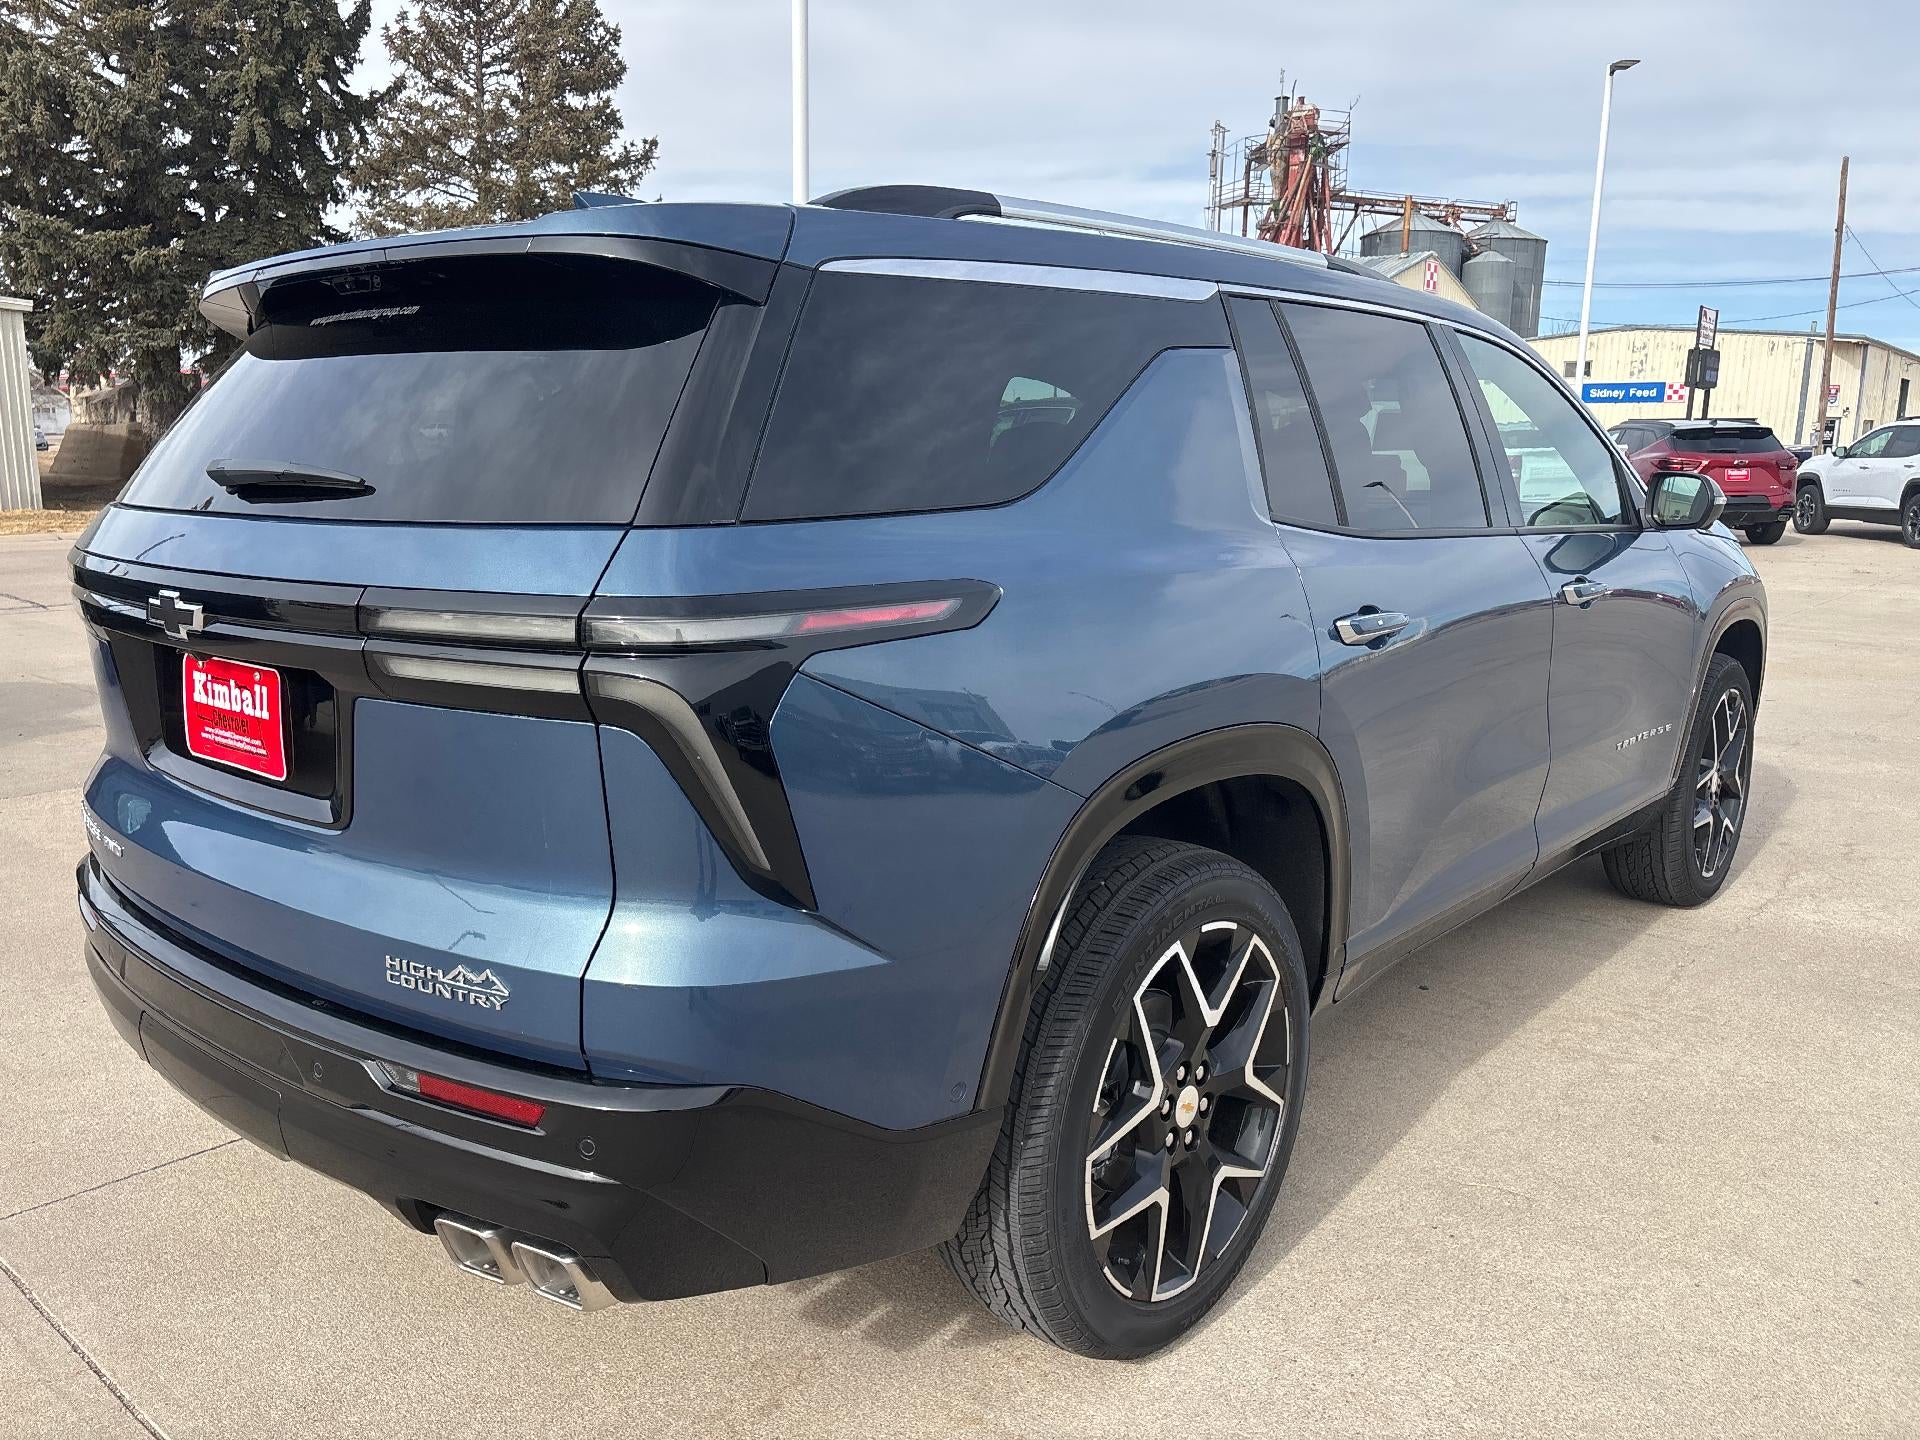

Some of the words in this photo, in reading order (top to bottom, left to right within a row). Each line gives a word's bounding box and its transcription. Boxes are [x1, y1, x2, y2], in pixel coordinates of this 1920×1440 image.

[1589, 388, 1625, 400] Sidney
[1629, 387, 1657, 398] Feed
[192, 670, 270, 720] Kimball
[212, 709, 250, 734] Chevrolet
[1616, 723, 1672, 751] TRAVERSE
[385, 955, 444, 981] HIGH
[386, 970, 509, 1011] COUNTRY
